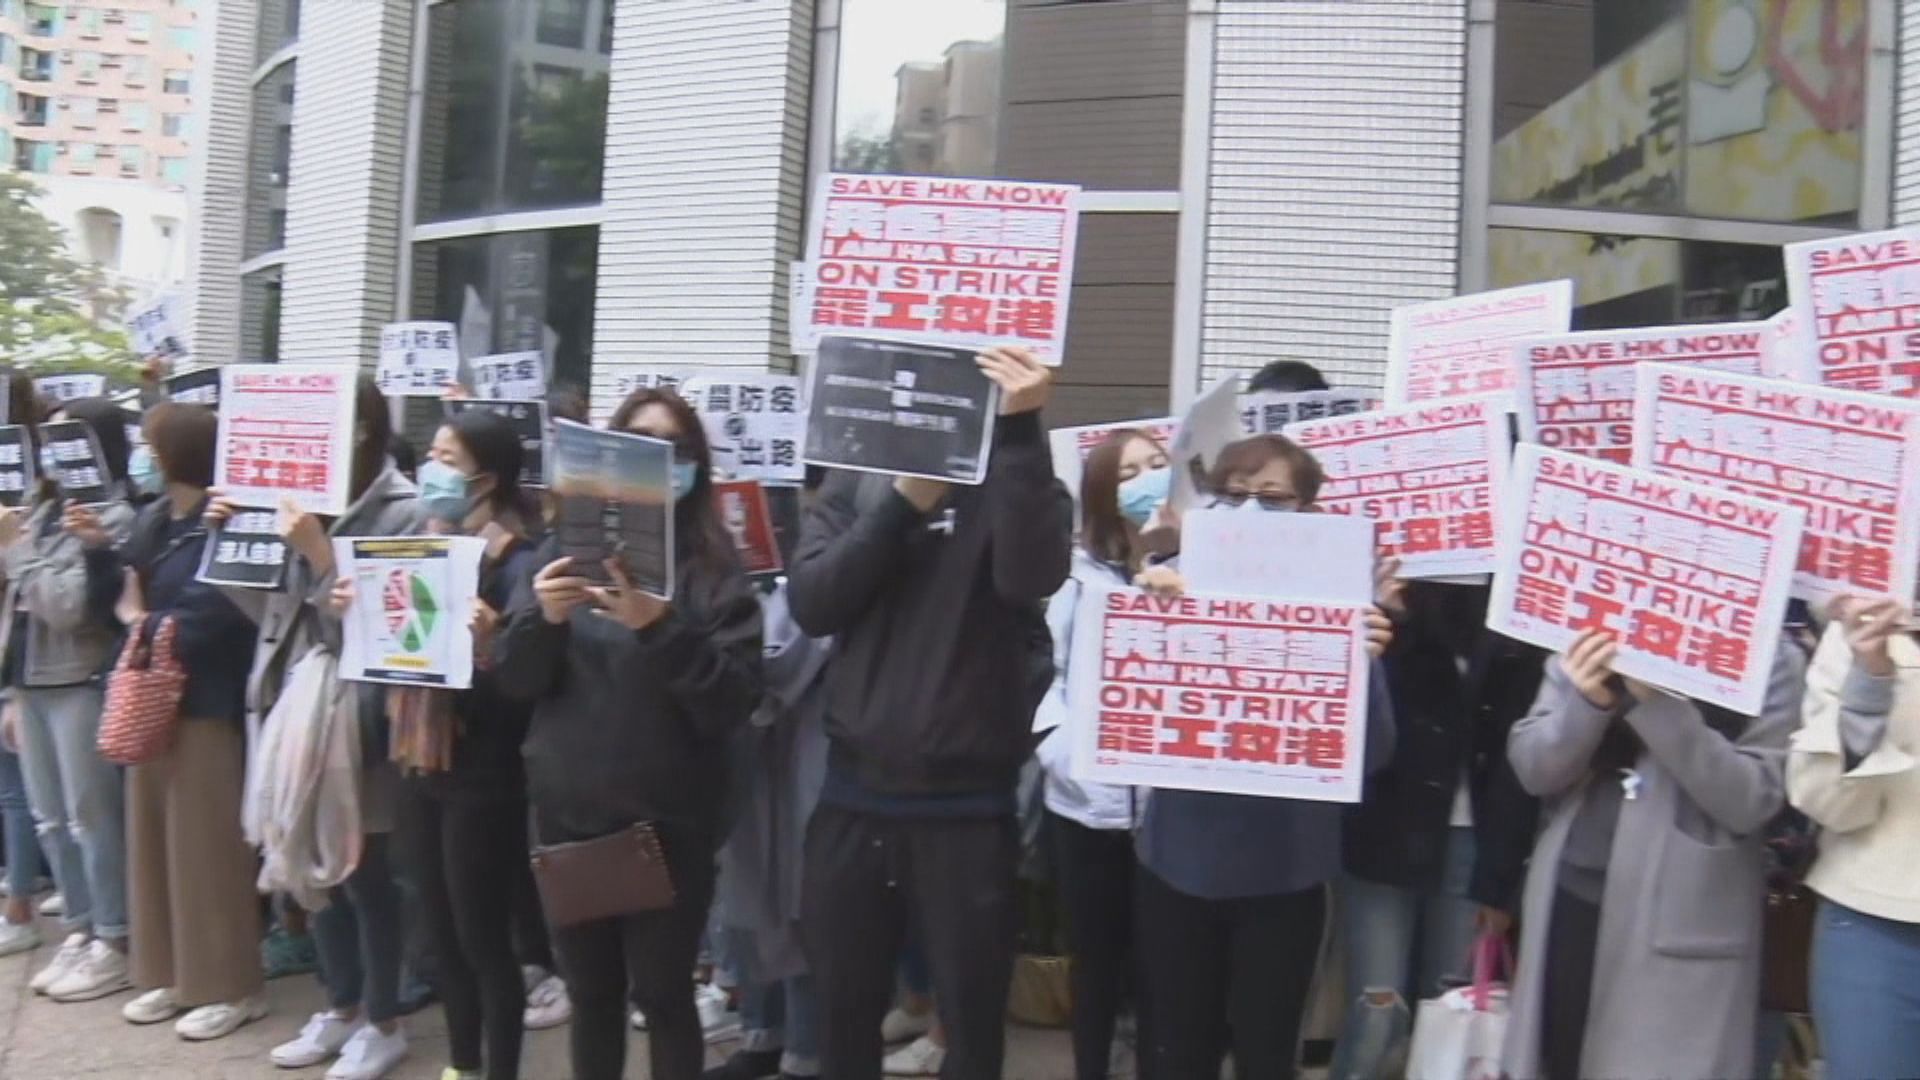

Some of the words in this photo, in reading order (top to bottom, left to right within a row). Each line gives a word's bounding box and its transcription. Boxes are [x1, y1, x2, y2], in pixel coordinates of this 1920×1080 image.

[831, 178, 918, 197] SAVE
[927, 182, 972, 199] HK
[984, 185, 1068, 205] NOW
[1810, 240, 1907, 270] SAVE
[816, 262, 879, 287] ON
[894, 266, 1058, 297] STRIKE
[1530, 342, 1614, 364] SAVE
[1622, 339, 1666, 357] HK
[1677, 332, 1761, 354] NOW
[1819, 337, 1887, 367] ON
[1658, 375, 1744, 405] SAVE
[1756, 390, 1800, 414] HK
[1814, 400, 1906, 432] NOW
[1301, 420, 1363, 443] SAVE
[1420, 402, 1483, 422] NOW
[1538, 427, 1596, 447] ON
[1363, 486, 1489, 519] STRIKE
[1538, 456, 1620, 492] SAVE
[1630, 478, 1676, 508] HK
[1688, 492, 1779, 530] NOW
[1106, 592, 1197, 616] SAVE
[1207, 600, 1254, 620] HK
[1267, 604, 1355, 627] NOW
[1520, 549, 1578, 584] ON
[1592, 569, 1756, 637] STRIKE
[1120, 661, 1176, 682] AM
[1180, 665, 1231, 687] HA
[1235, 669, 1348, 696] STAFF
[1100, 685, 1163, 711] ON
[1178, 689, 1347, 725] STRIKE
